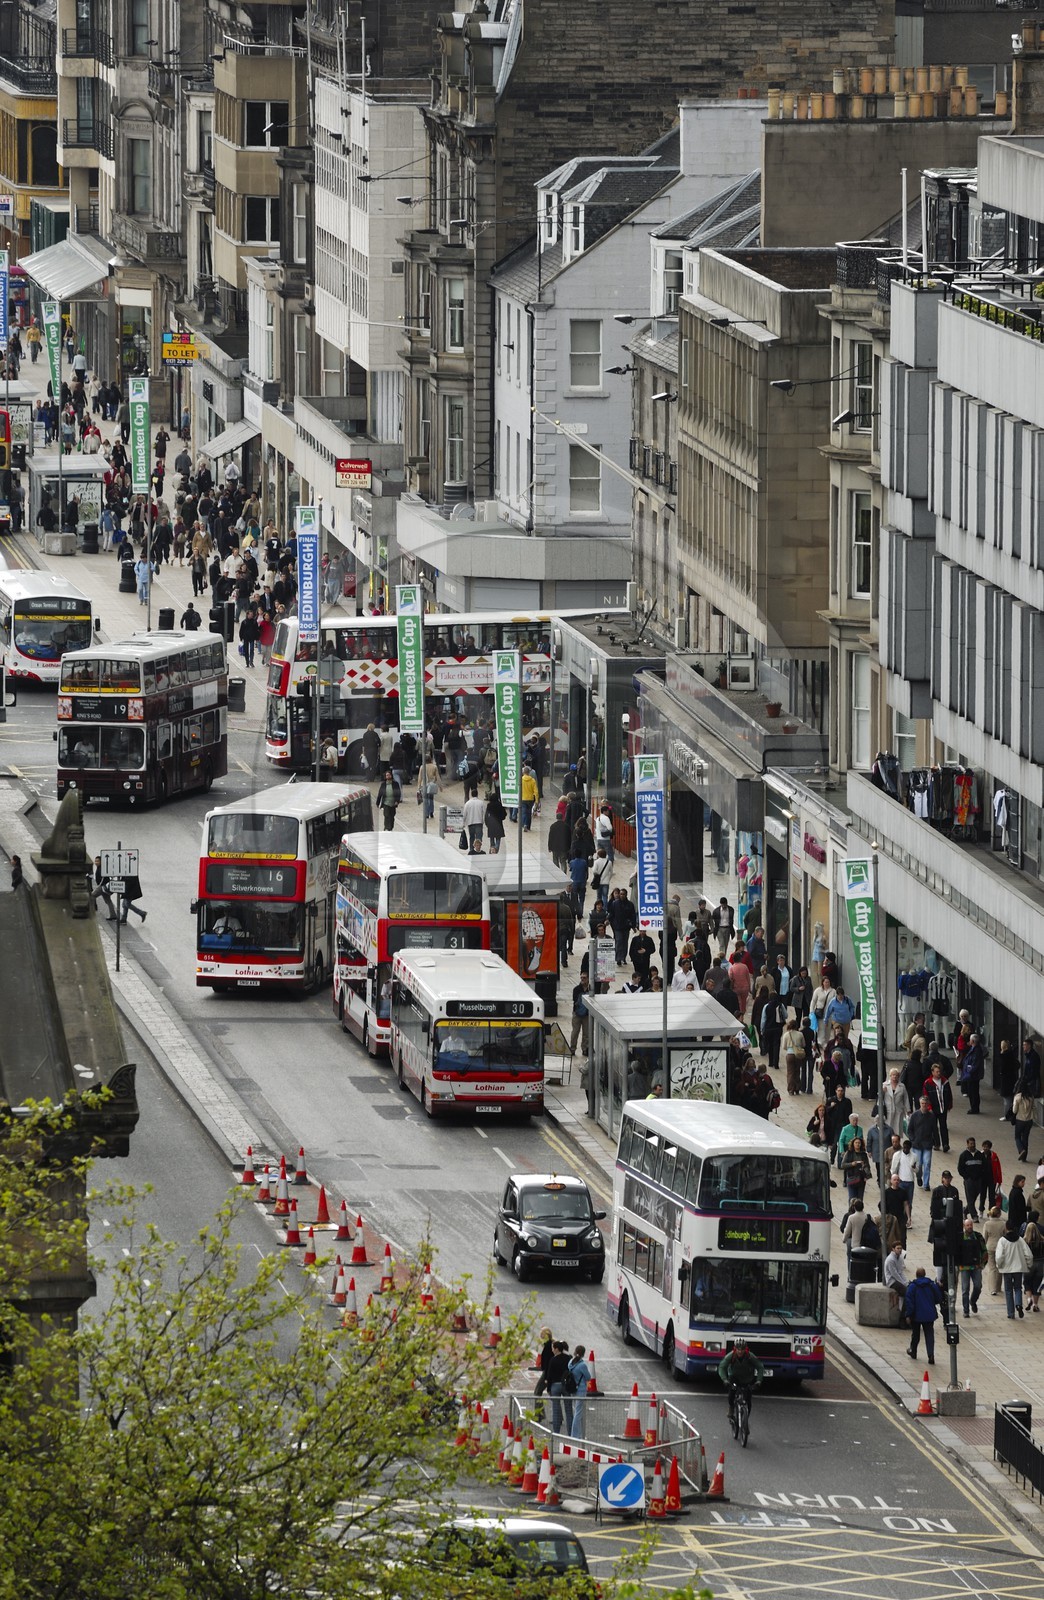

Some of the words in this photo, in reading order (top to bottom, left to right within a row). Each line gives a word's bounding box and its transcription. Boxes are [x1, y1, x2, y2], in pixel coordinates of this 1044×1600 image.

[134, 404, 146, 426] Cup
[136, 428, 147, 482] Heineken
[271, 540, 278, 549] 7
[302, 543, 314, 622] EDINBURGH
[66, 601, 77, 610] 22
[402, 618, 417, 647] Cup
[440, 671, 456, 680] Take
[457, 671, 469, 680] the
[403, 650, 417, 718] Heineken
[500, 685, 516, 715] Cup
[114, 704, 127, 715] 19
[503, 718, 517, 791] Heineken
[637, 794, 662, 802] FINAL
[642, 803, 659, 905] EDINBURGH
[269, 870, 284, 882] 16
[231, 884, 274, 893] Silverknowes
[640, 906, 664, 915] 2005
[853, 901, 872, 938] Cup
[450, 936, 465, 949] 31
[235, 968, 263, 976] Lothian
[859, 940, 878, 1029] Heineken
[459, 1003, 497, 1012] Musselburgh
[512, 1003, 525, 1014] 30
[670, 1065, 725, 1091] Ghoulies
[474, 1084, 506, 1092] Lothian
[786, 1229, 801, 1245] 27
[793, 1336, 812, 1345] First
[753, 1491, 904, 1511] TURN
[710, 1510, 847, 1529] LEFT
[882, 1516, 958, 1533] NO
